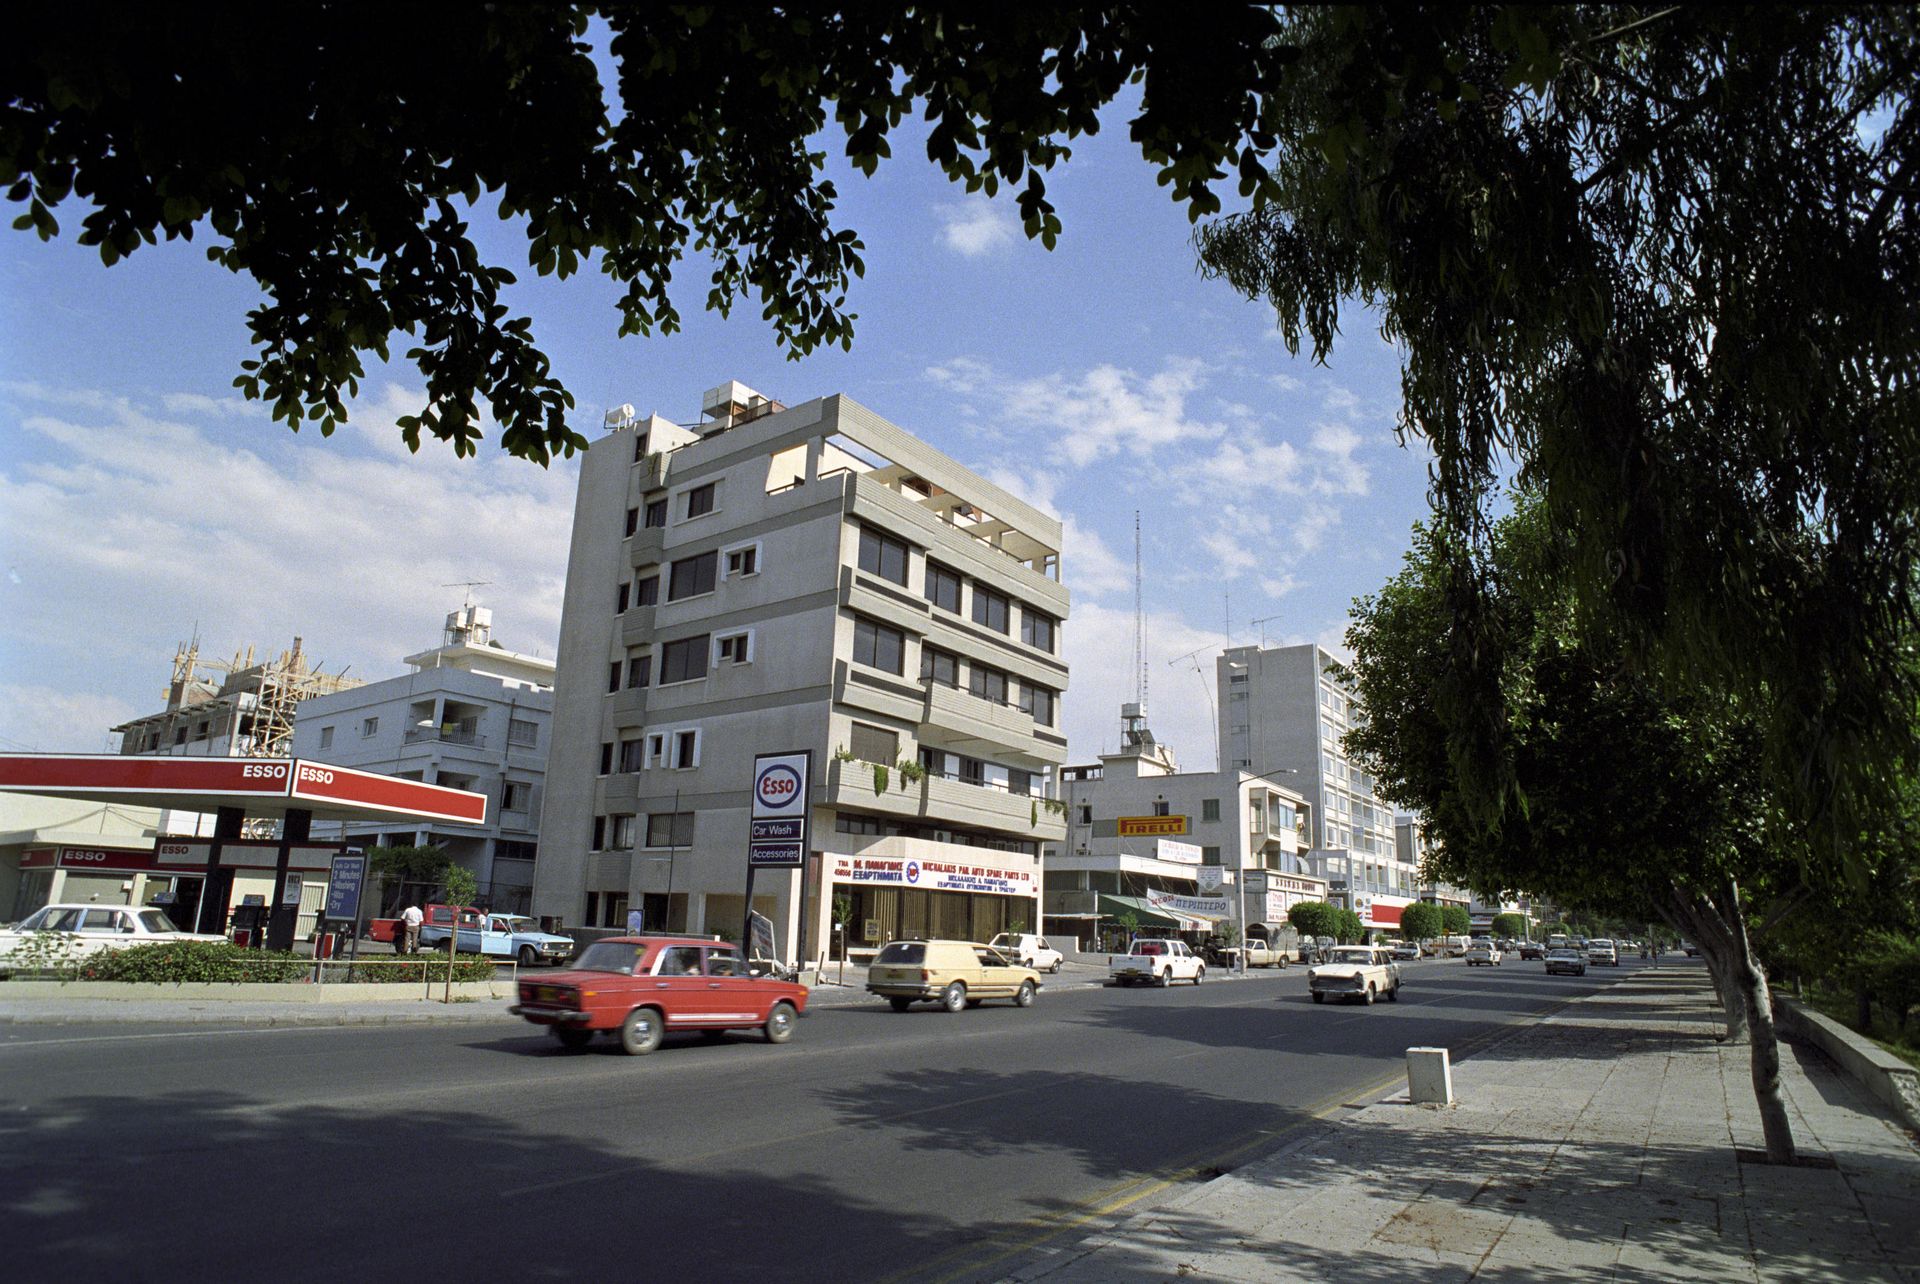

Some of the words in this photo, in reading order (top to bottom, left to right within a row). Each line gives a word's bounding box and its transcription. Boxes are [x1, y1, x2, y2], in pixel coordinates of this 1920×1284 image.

[243, 765, 286, 779] ESSO
[300, 767, 334, 784] ESSO
[753, 825, 767, 836] Car
[769, 825, 792, 835] Wash
[1120, 818, 1183, 833] PIRELLI
[161, 844, 189, 855] ESSO
[752, 848, 799, 859] Accessories
[64, 850, 106, 861] ESSO
[339, 870, 360, 880] Minutes
[922, 862, 956, 873] MICHALAKIS
[971, 867, 985, 877] AUTO
[986, 868, 1002, 879] SPARE
[1004, 871, 1019, 880] PARTS
[1021, 873, 1029, 881] LTD
[1175, 899, 1226, 911] ΠΕΡΙΠΤΕΡΟ
